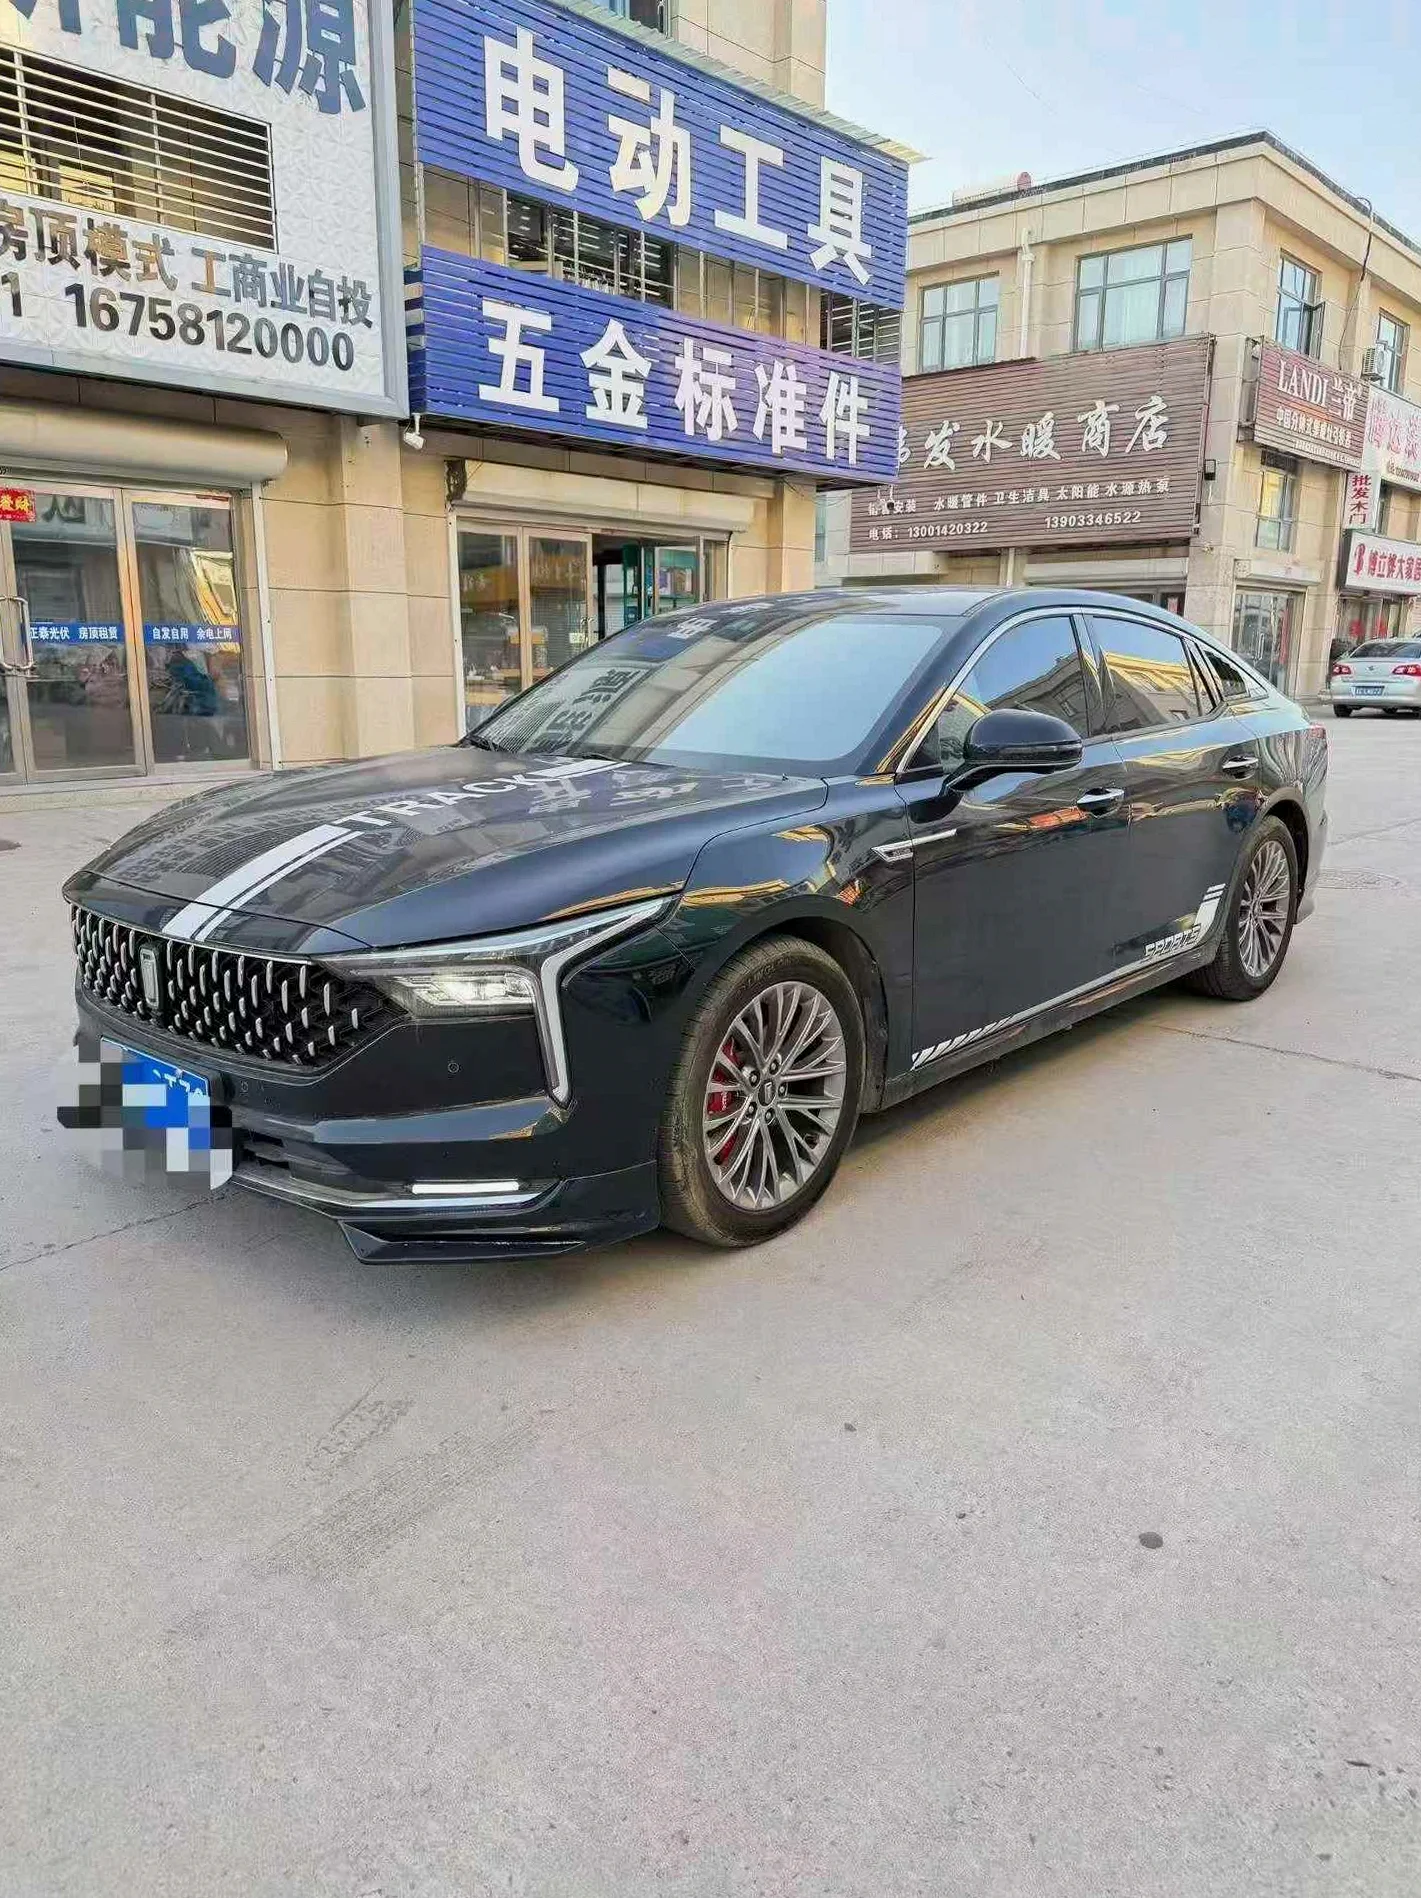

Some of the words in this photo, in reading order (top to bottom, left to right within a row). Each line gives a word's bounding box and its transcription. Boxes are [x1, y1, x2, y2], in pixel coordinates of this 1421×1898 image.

[6, 0, 367, 114] 能源
[483, 26, 873, 286] 电动工具
[191, 246, 374, 329] 工商业自投
[65, 282, 355, 372] 16758120000
[478, 299, 870, 467] 五金标准件
[1278, 360, 1329, 408] LANDI
[907, 521, 988, 538] 13001420322
[1045, 510, 1142, 529] 13903346522
[934, 492, 988, 511] 水暖管件
[994, 487, 1050, 505] 卫生洁具
[1056, 484, 1100, 501] 太阳能
[1105, 475, 1171, 497] 水源热泵
[29, 626, 70, 640] 正泰光伏
[78, 626, 118, 640] 房顶租赁
[152, 626, 189, 640] 自发自用
[196, 627, 233, 640] 余电上网
[332, 773, 539, 827] TRACK
